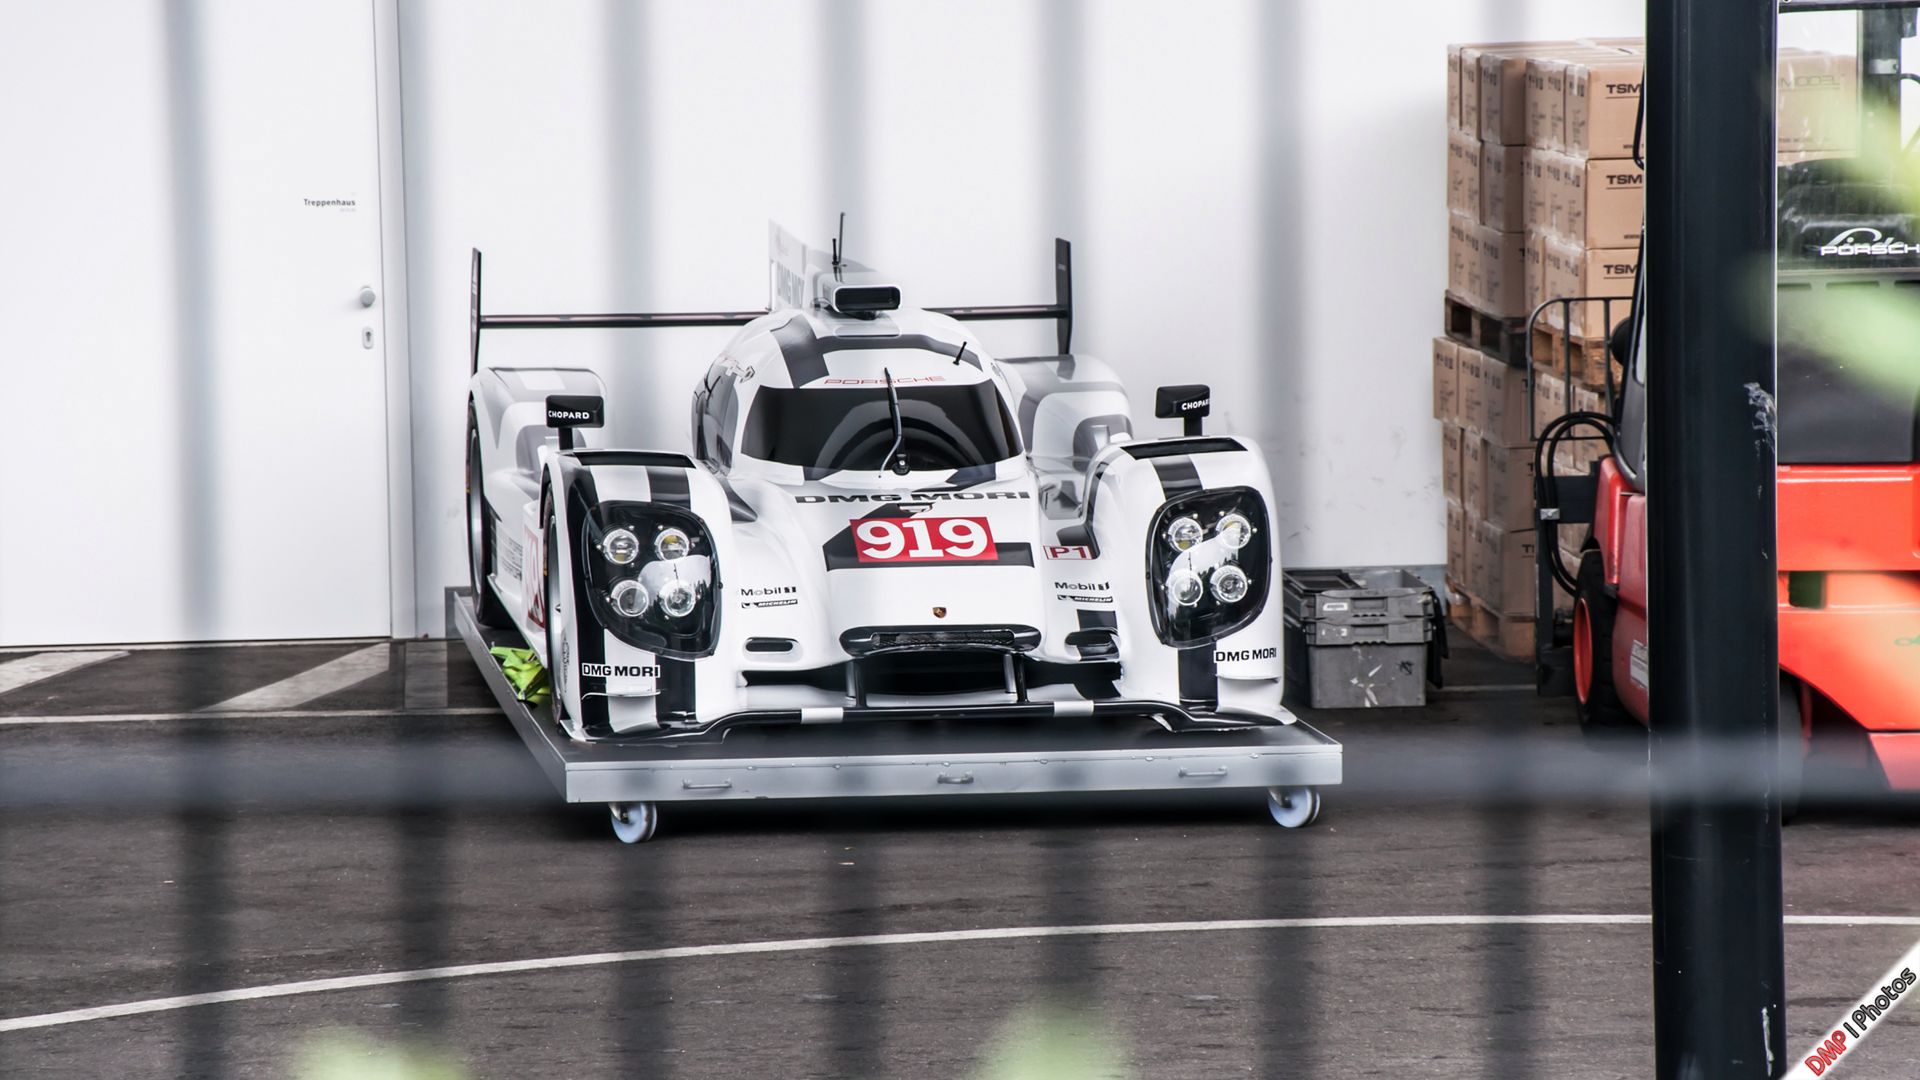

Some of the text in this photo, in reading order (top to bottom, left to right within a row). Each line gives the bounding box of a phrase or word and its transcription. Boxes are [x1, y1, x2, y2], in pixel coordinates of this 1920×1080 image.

[1606, 174, 1643, 185] TSM
[303, 198, 356, 207] Treppenhaus
[824, 376, 946, 385] PORSCHE
[548, 410, 590, 420] CHOPARD
[795, 491, 1031, 504] DMG MORI
[856, 518, 988, 559] 919
[1050, 546, 1087, 559] P1
[1054, 581, 1096, 590] Mobil
[740, 587, 782, 596] Mobil
[1215, 647, 1277, 662] DMG MORI
[583, 665, 659, 677] DMG MORI
